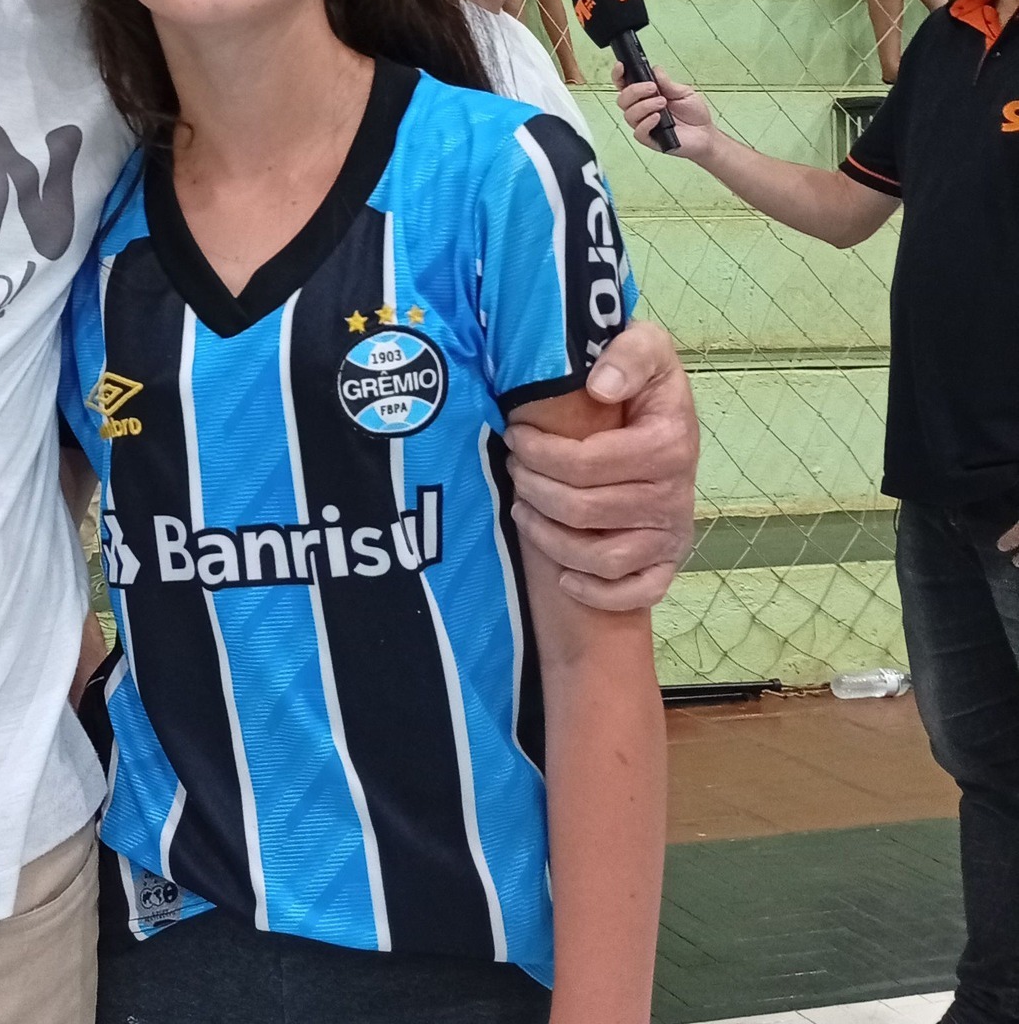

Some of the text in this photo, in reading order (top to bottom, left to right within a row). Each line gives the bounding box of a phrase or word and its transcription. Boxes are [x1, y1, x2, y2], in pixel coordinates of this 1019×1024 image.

[371, 349, 402, 365] 1903
[342, 368, 438, 401] GRÊMIO
[380, 401, 408, 416] FBPA
[153, 491, 438, 586] Banrisul
